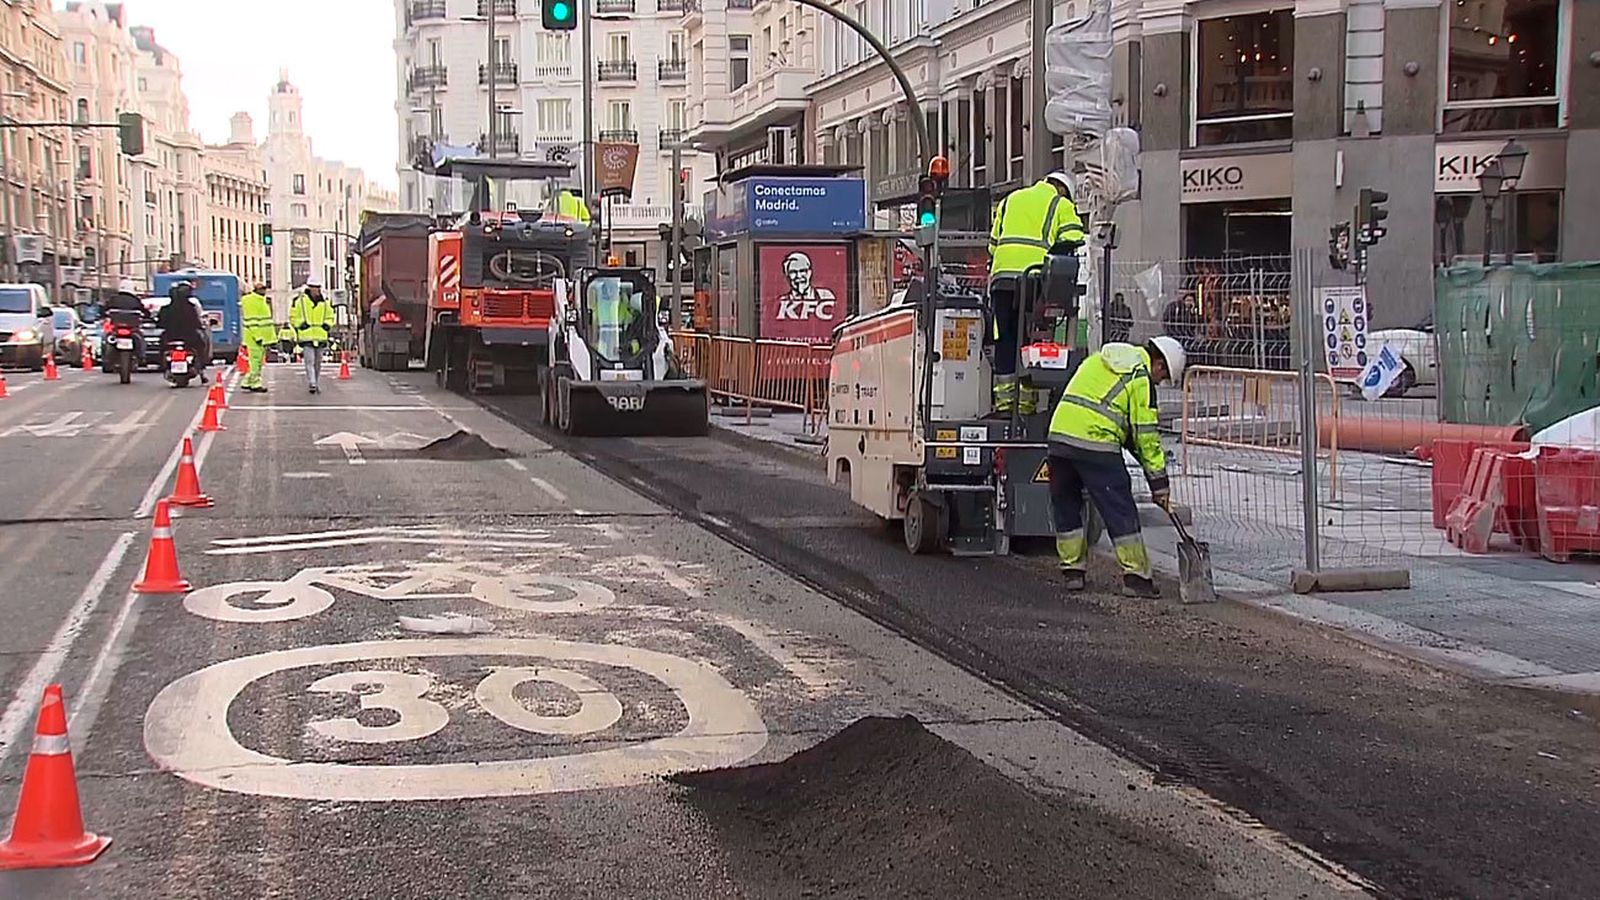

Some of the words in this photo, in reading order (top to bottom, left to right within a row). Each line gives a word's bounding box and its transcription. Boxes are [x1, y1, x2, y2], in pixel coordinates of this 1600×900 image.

[1439, 154, 1496, 175] KIK
[1183, 166, 1243, 187] KIKO
[754, 184, 827, 196] Conectamos
[755, 198, 800, 211] Madrid.
[775, 300, 835, 320] KFC
[305, 666, 623, 742] 30
